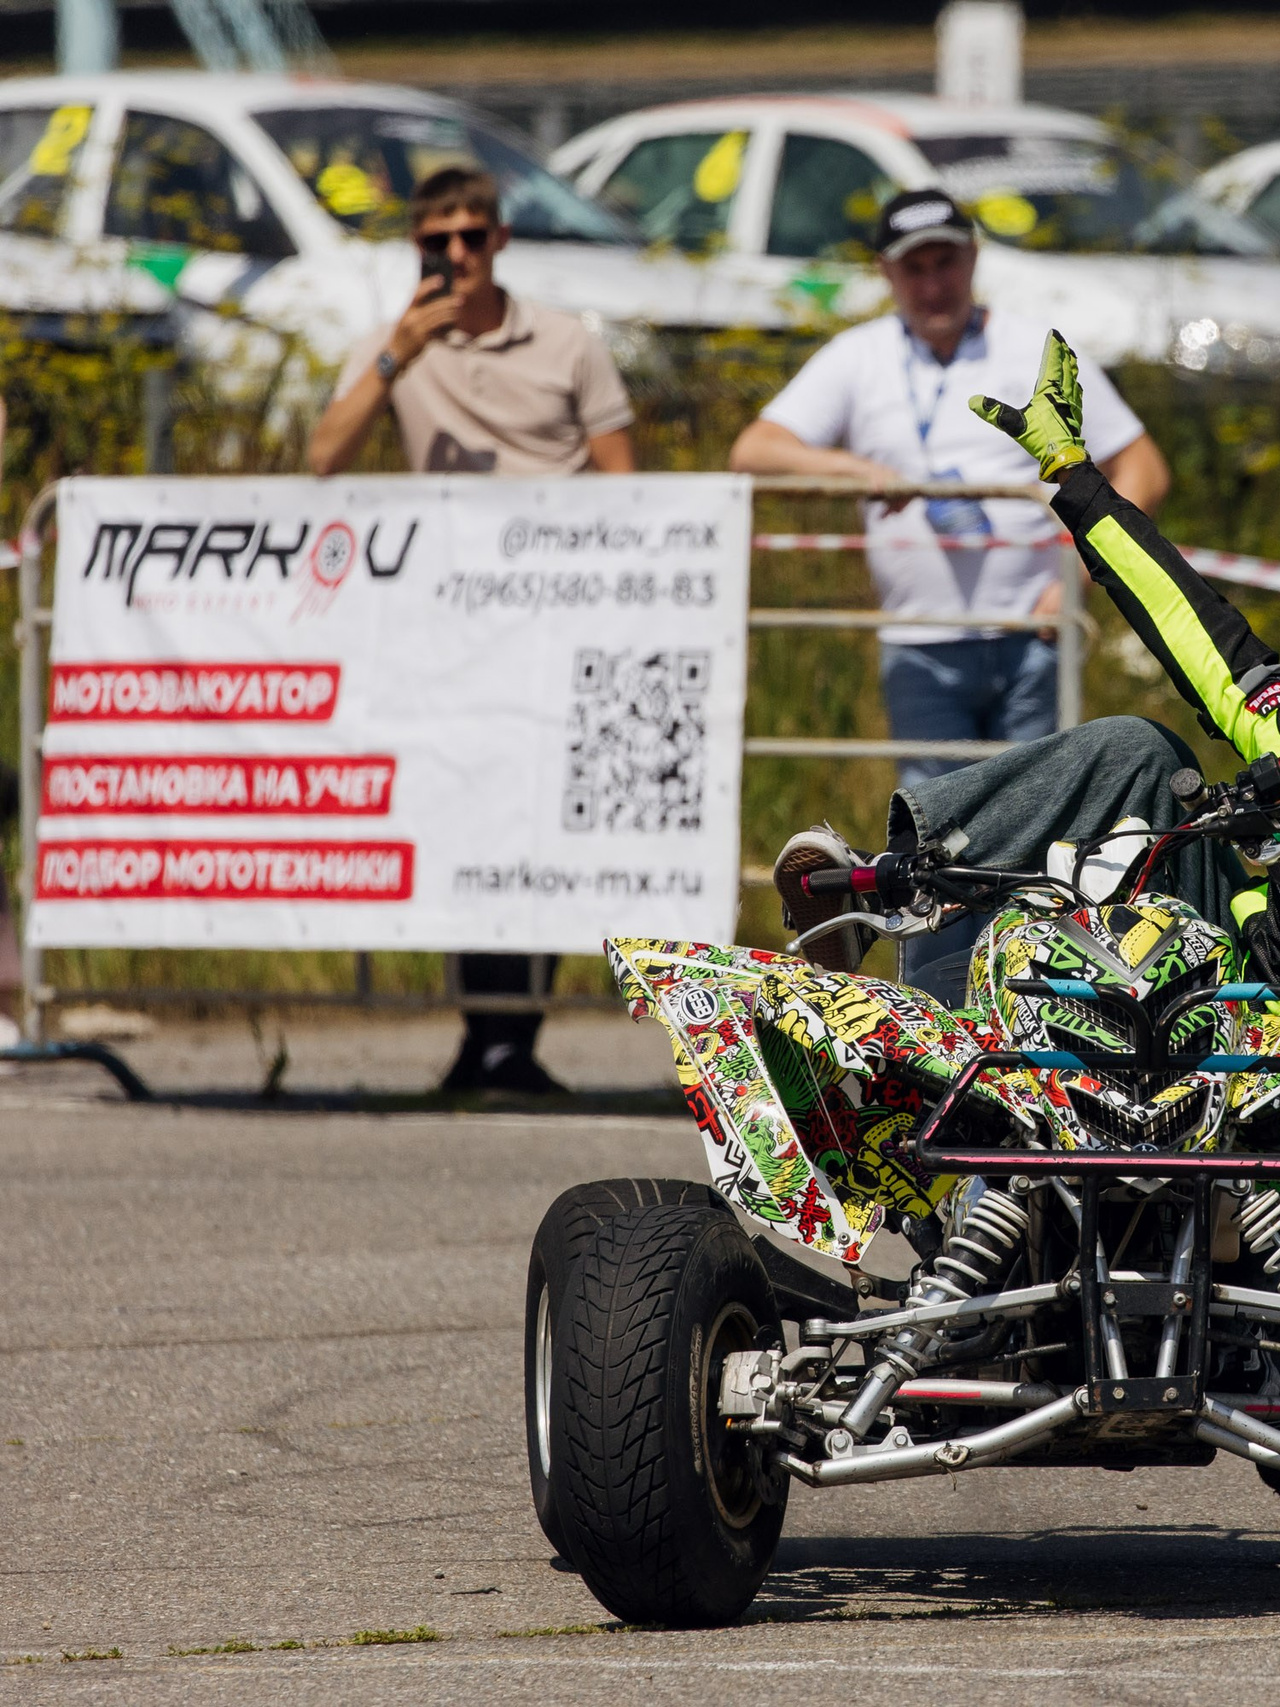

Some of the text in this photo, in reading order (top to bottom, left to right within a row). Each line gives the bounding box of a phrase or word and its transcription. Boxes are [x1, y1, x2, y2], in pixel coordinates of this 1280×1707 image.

[501, 516, 719, 558] @markov_mx
[84, 522, 420, 607] MARKOV
[54, 671, 332, 713] МОТОЭВАКУАТОР
[48, 765, 393, 807] ПОСТАНОВКА НА УЧЕТ
[42, 848, 402, 894] ПОДБОР МОТОТЕХНИКИ
[452, 857, 704, 896] markov-mx.ru
